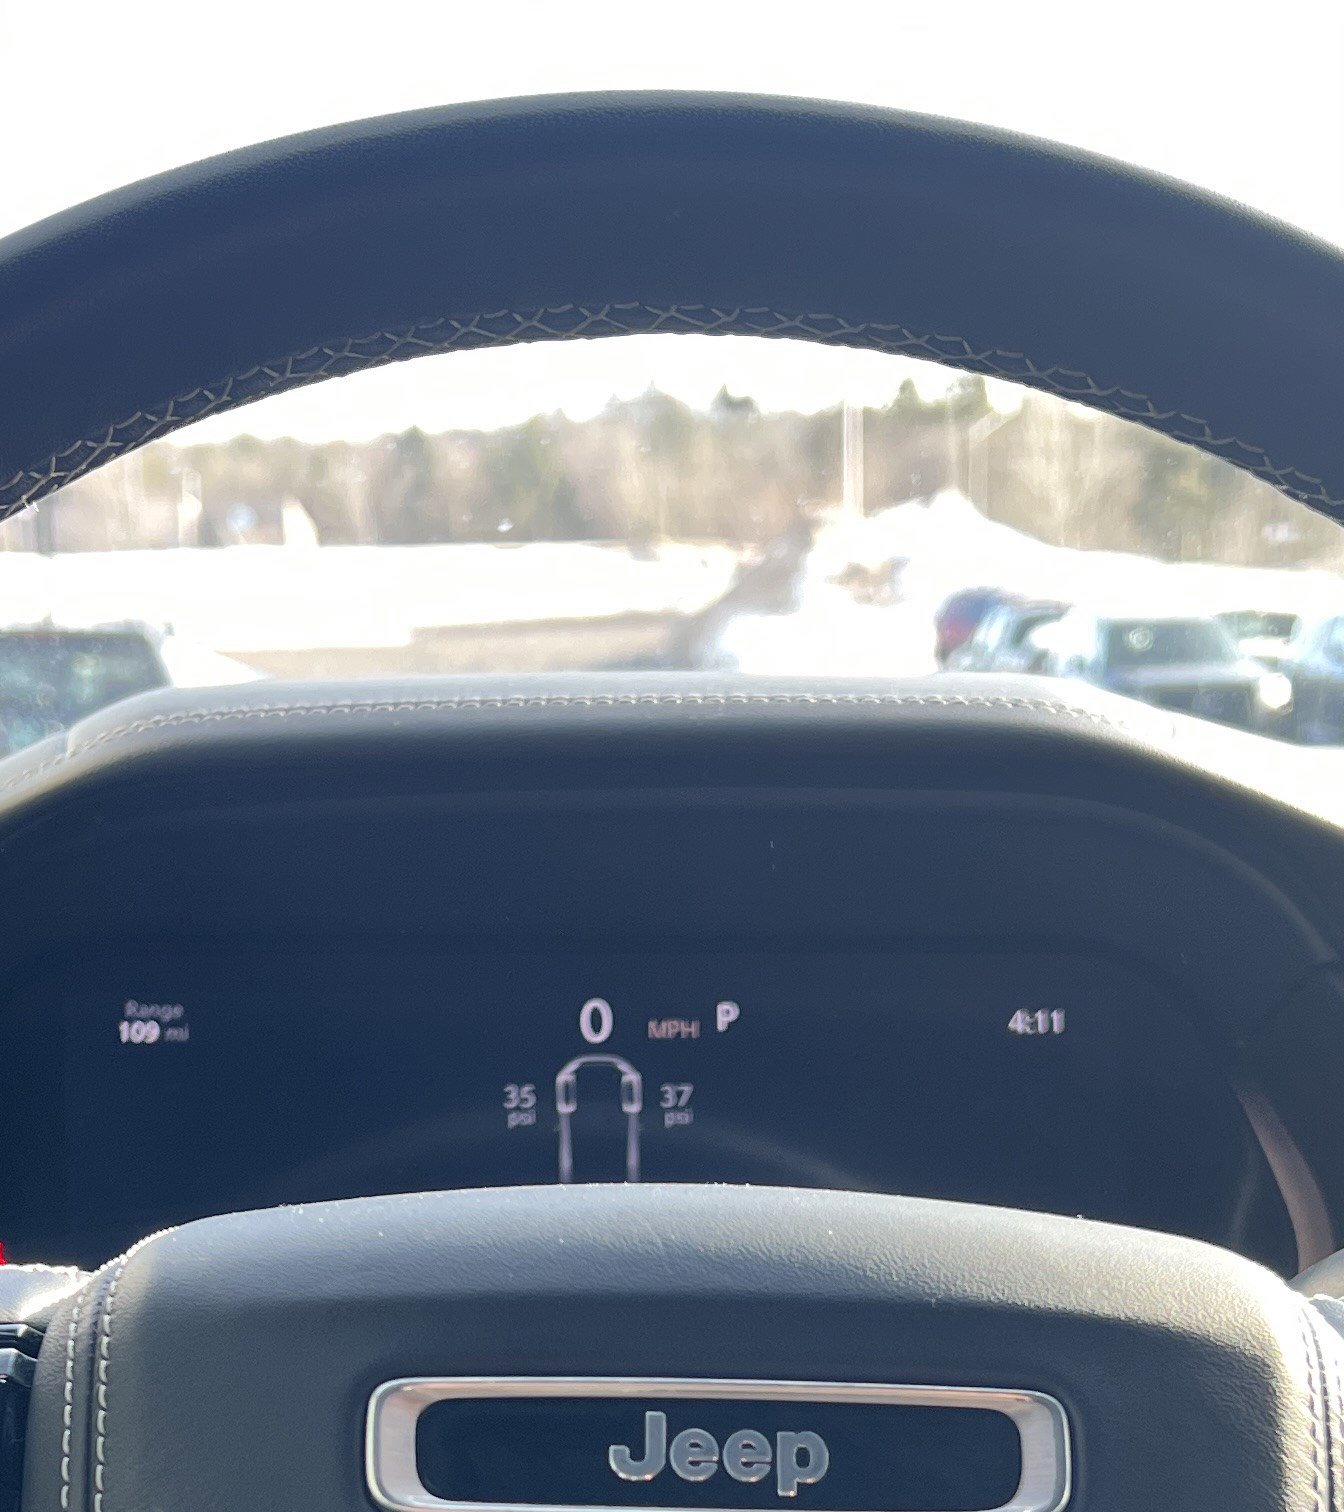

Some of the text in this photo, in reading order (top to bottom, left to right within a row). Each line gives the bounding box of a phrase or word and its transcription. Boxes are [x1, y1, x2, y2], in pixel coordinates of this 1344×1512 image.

[124, 999, 184, 1020] Range
[579, 997, 700, 1044] 0 MPH
[715, 1001, 740, 1033] P
[1007, 1007, 1065, 1034] 4:11
[118, 1020, 191, 1044] 109 mi
[503, 1083, 537, 1110] 35
[659, 1083, 694, 1110] 37
[608, 1410, 830, 1498] Jeep
